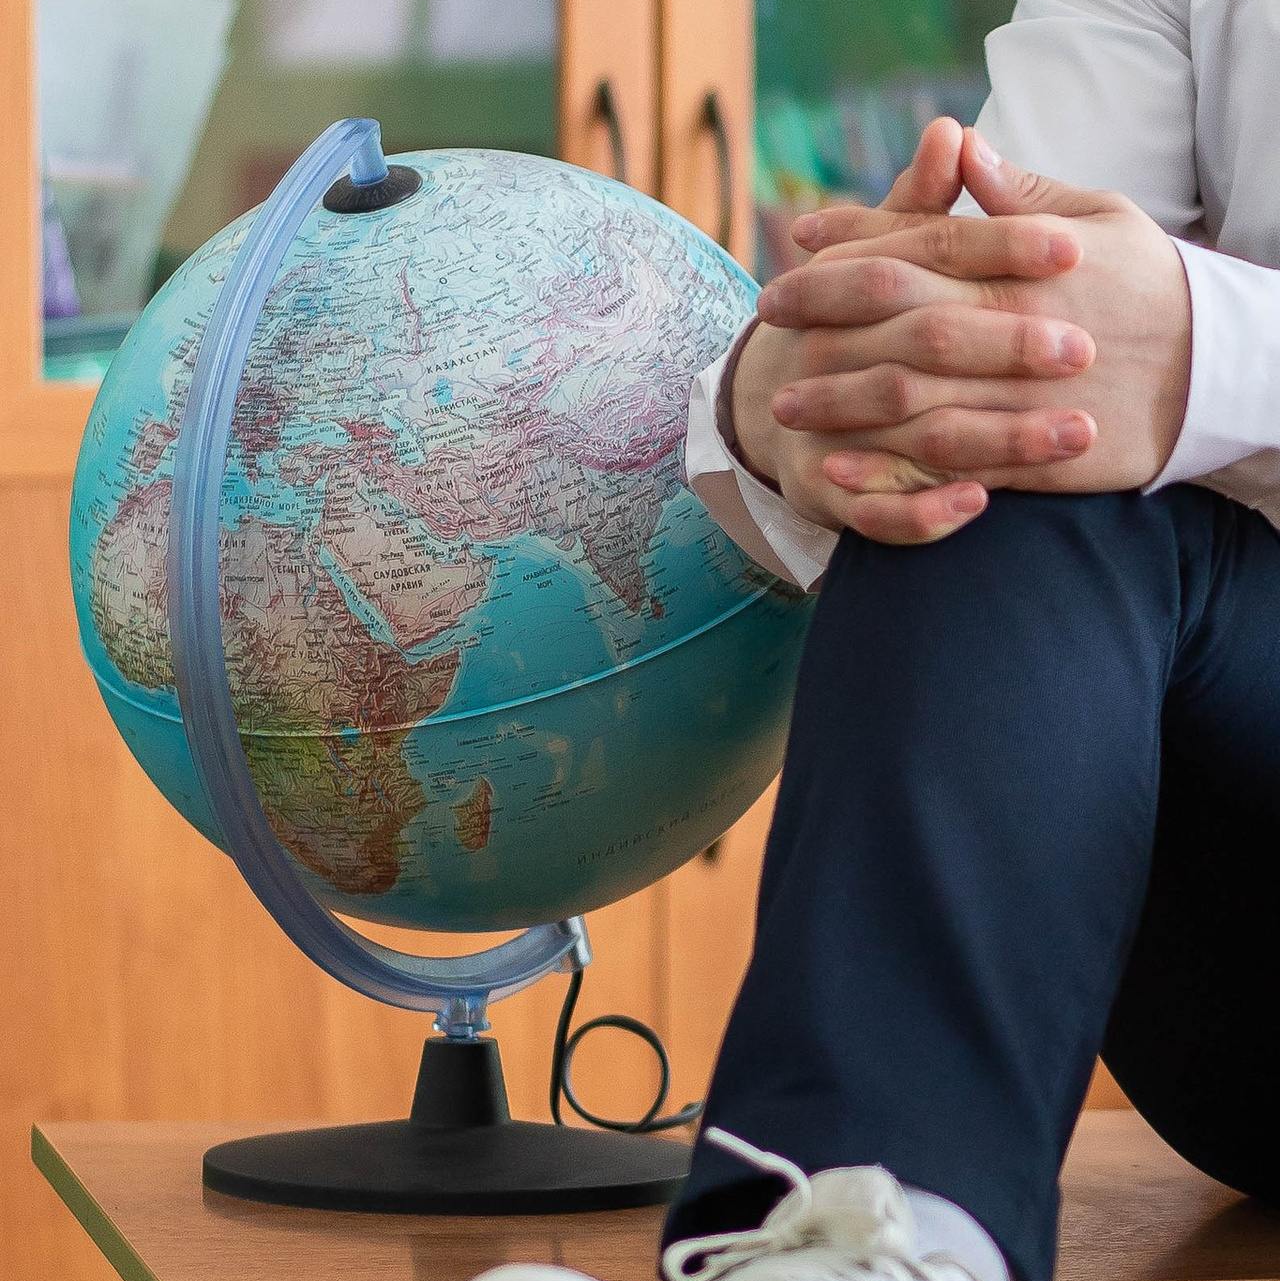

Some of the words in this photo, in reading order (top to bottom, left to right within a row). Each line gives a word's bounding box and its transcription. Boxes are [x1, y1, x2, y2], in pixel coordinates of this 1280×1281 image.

[426, 345, 499, 374] КАЗАХСТАН
[424, 396, 478, 417] УЗБЕКИСТАН
[319, 425, 337, 433] МОРЕ
[421, 423, 478, 443] ТУРКМЕНИСТАН
[415, 480, 454, 495] ИРАН
[364, 502, 395, 513] ИРАК
[277, 564, 312, 574] ЕГИПЕТ
[373, 564, 431, 580] САУДОВСКАЯ
[390, 580, 424, 592] АРАВИЯ
[464, 580, 487, 591] ОМАН
